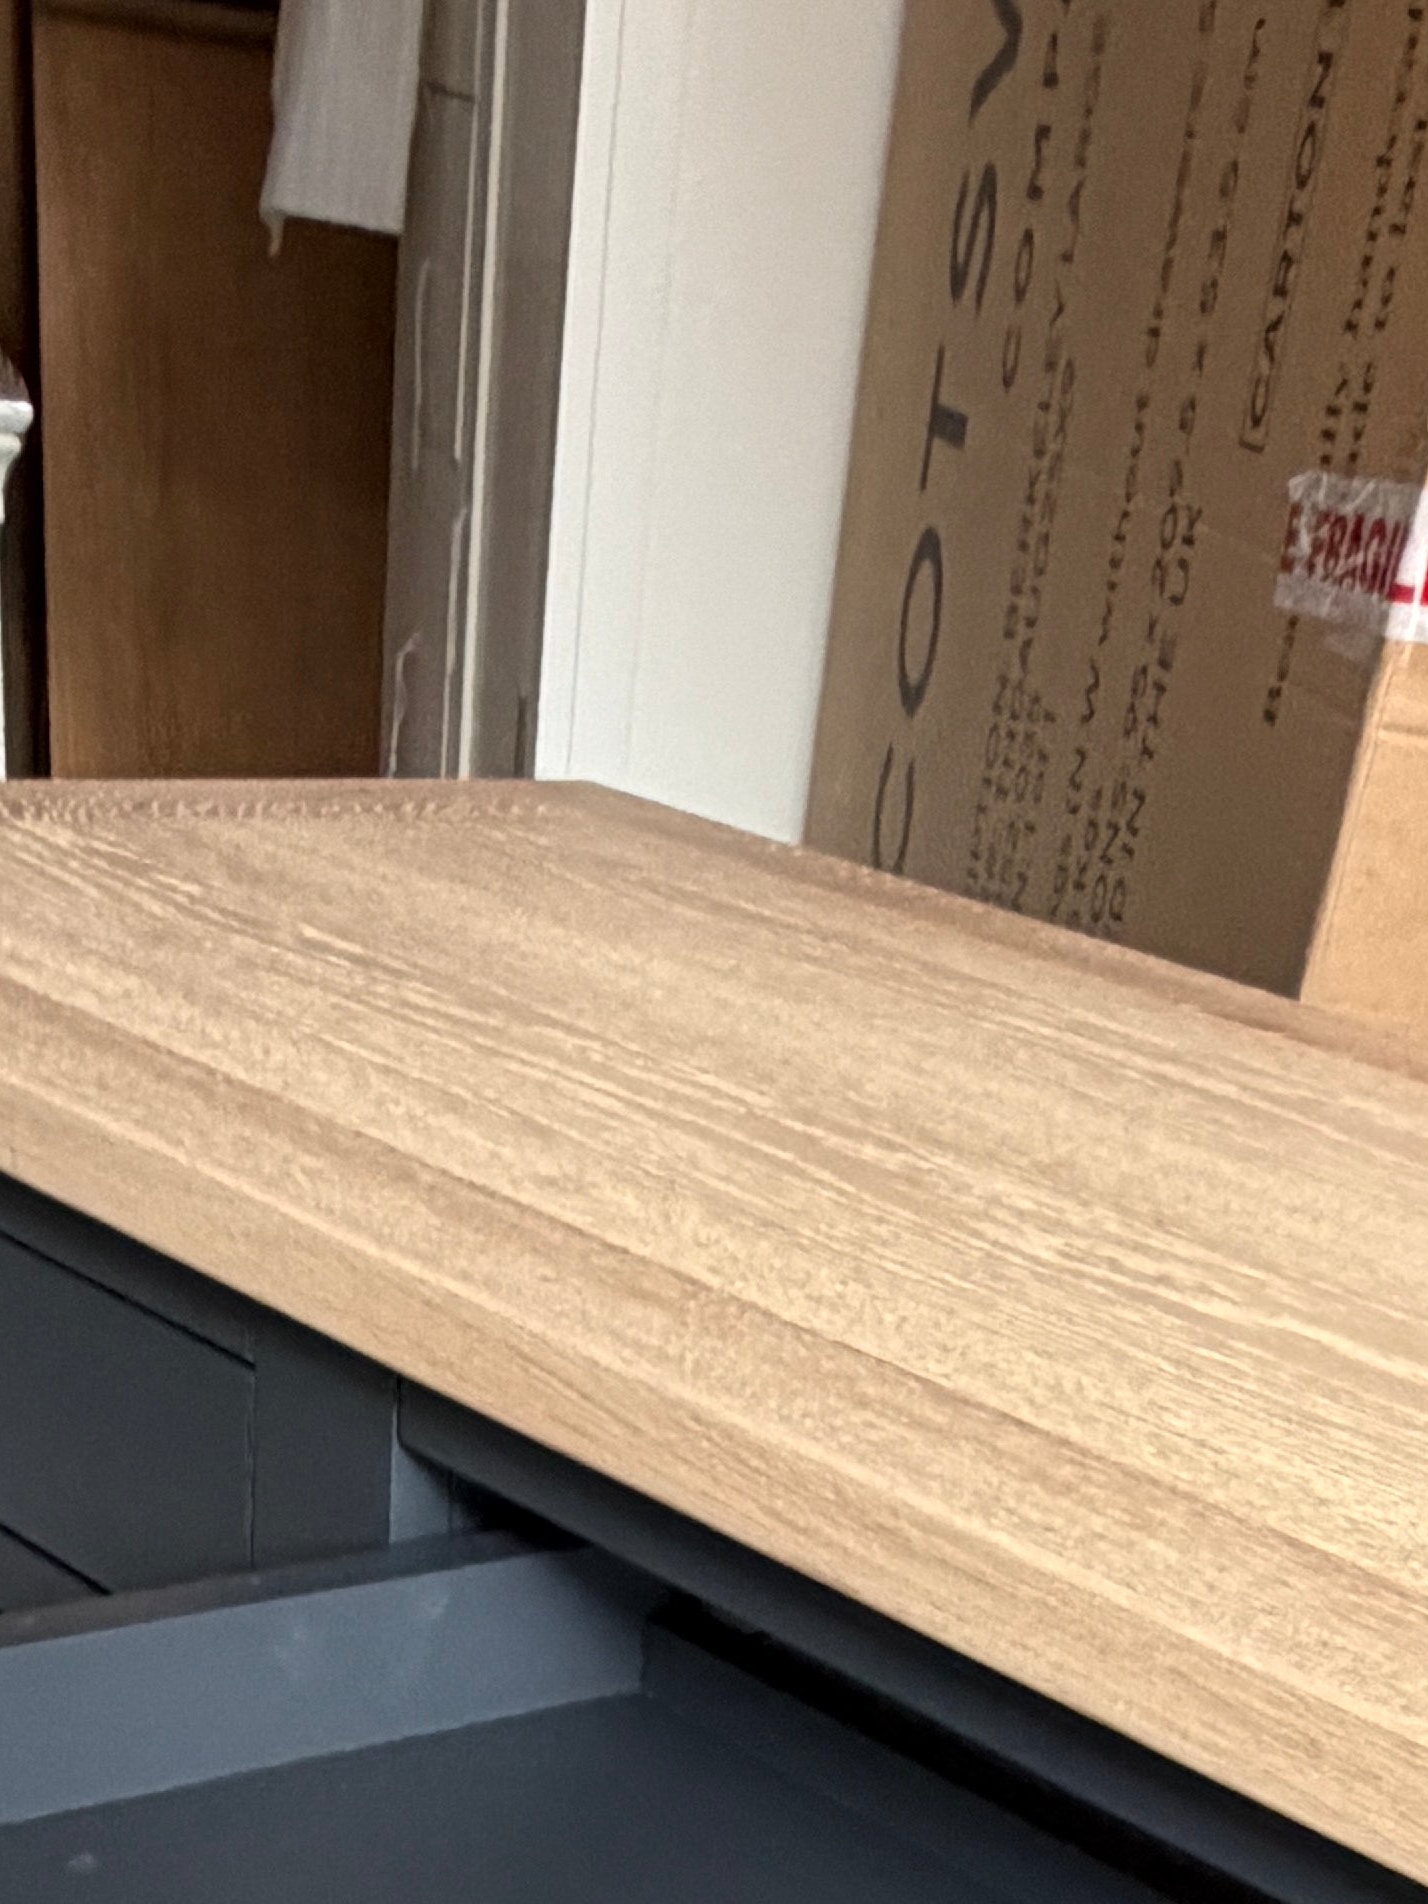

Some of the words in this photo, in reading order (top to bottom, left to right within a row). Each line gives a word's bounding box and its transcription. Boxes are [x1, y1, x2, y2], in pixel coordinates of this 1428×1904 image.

[1001, 0, 1070, 390] COMP
[1243, 46, 1337, 433] CARTON
[1166, 502, 1203, 608] UK
